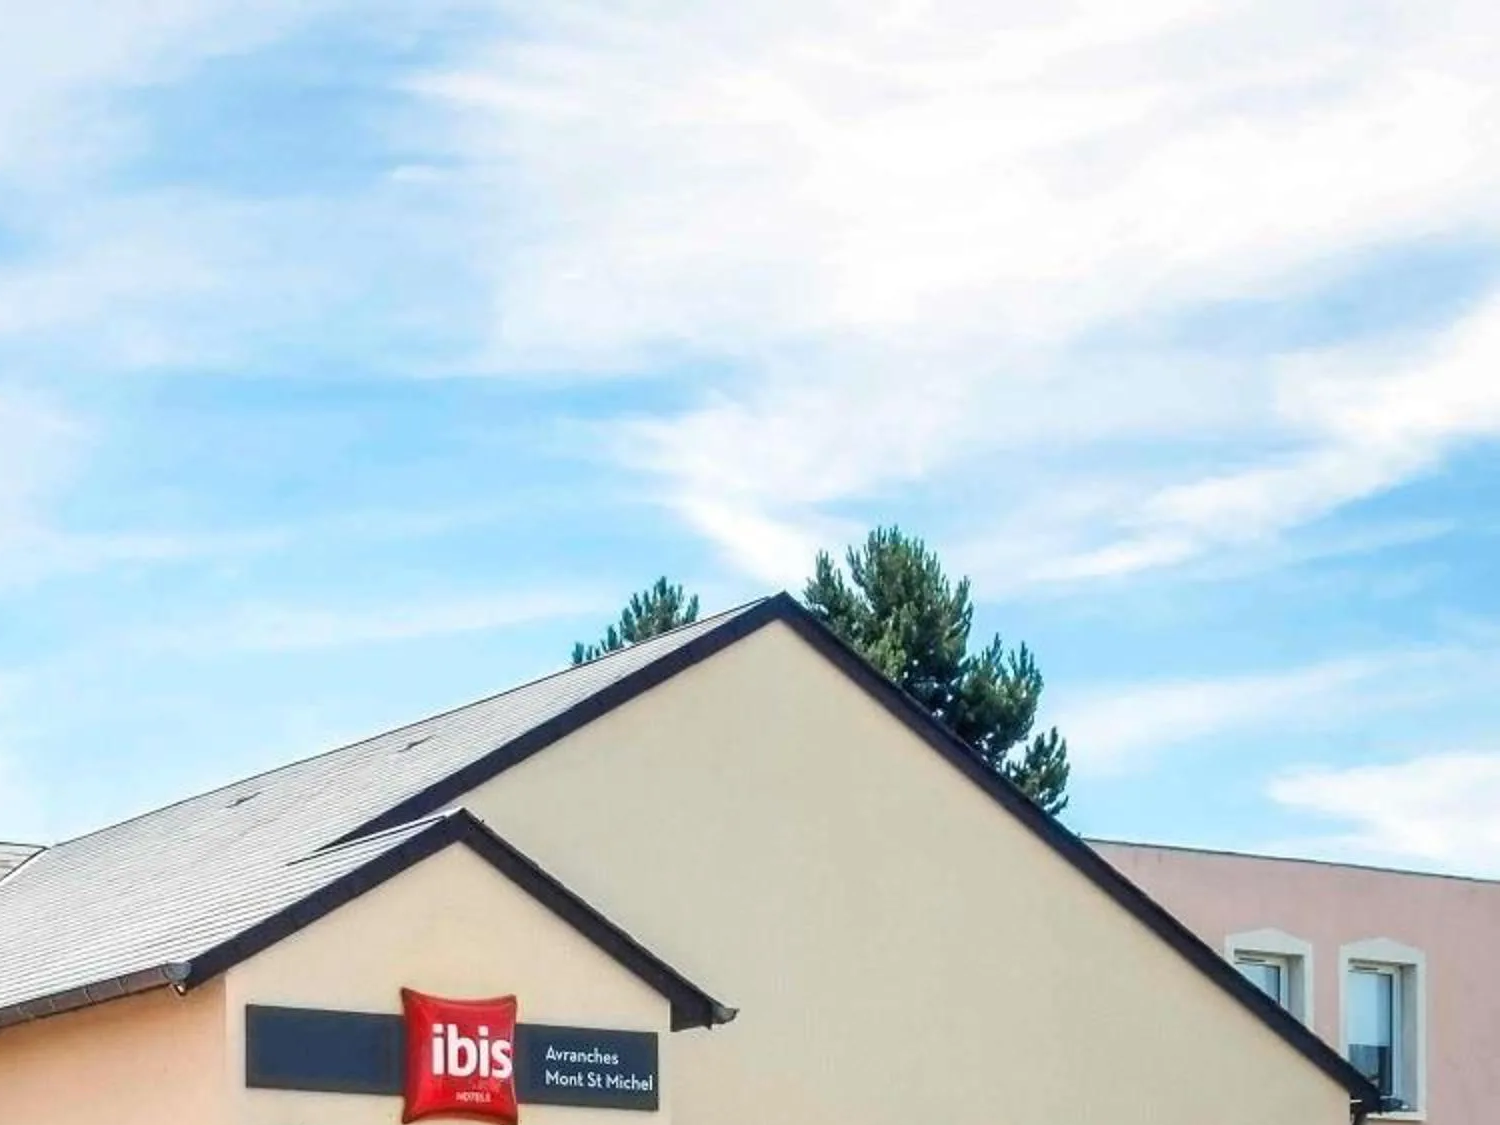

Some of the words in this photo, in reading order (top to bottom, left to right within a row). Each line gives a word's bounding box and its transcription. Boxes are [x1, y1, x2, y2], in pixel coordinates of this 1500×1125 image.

[432, 1023, 513, 1079] ibis
[545, 1045, 619, 1065] Avranches
[545, 1069, 584, 1087] Mont
[587, 1071, 603, 1089] St
[605, 1073, 653, 1091] Michel
